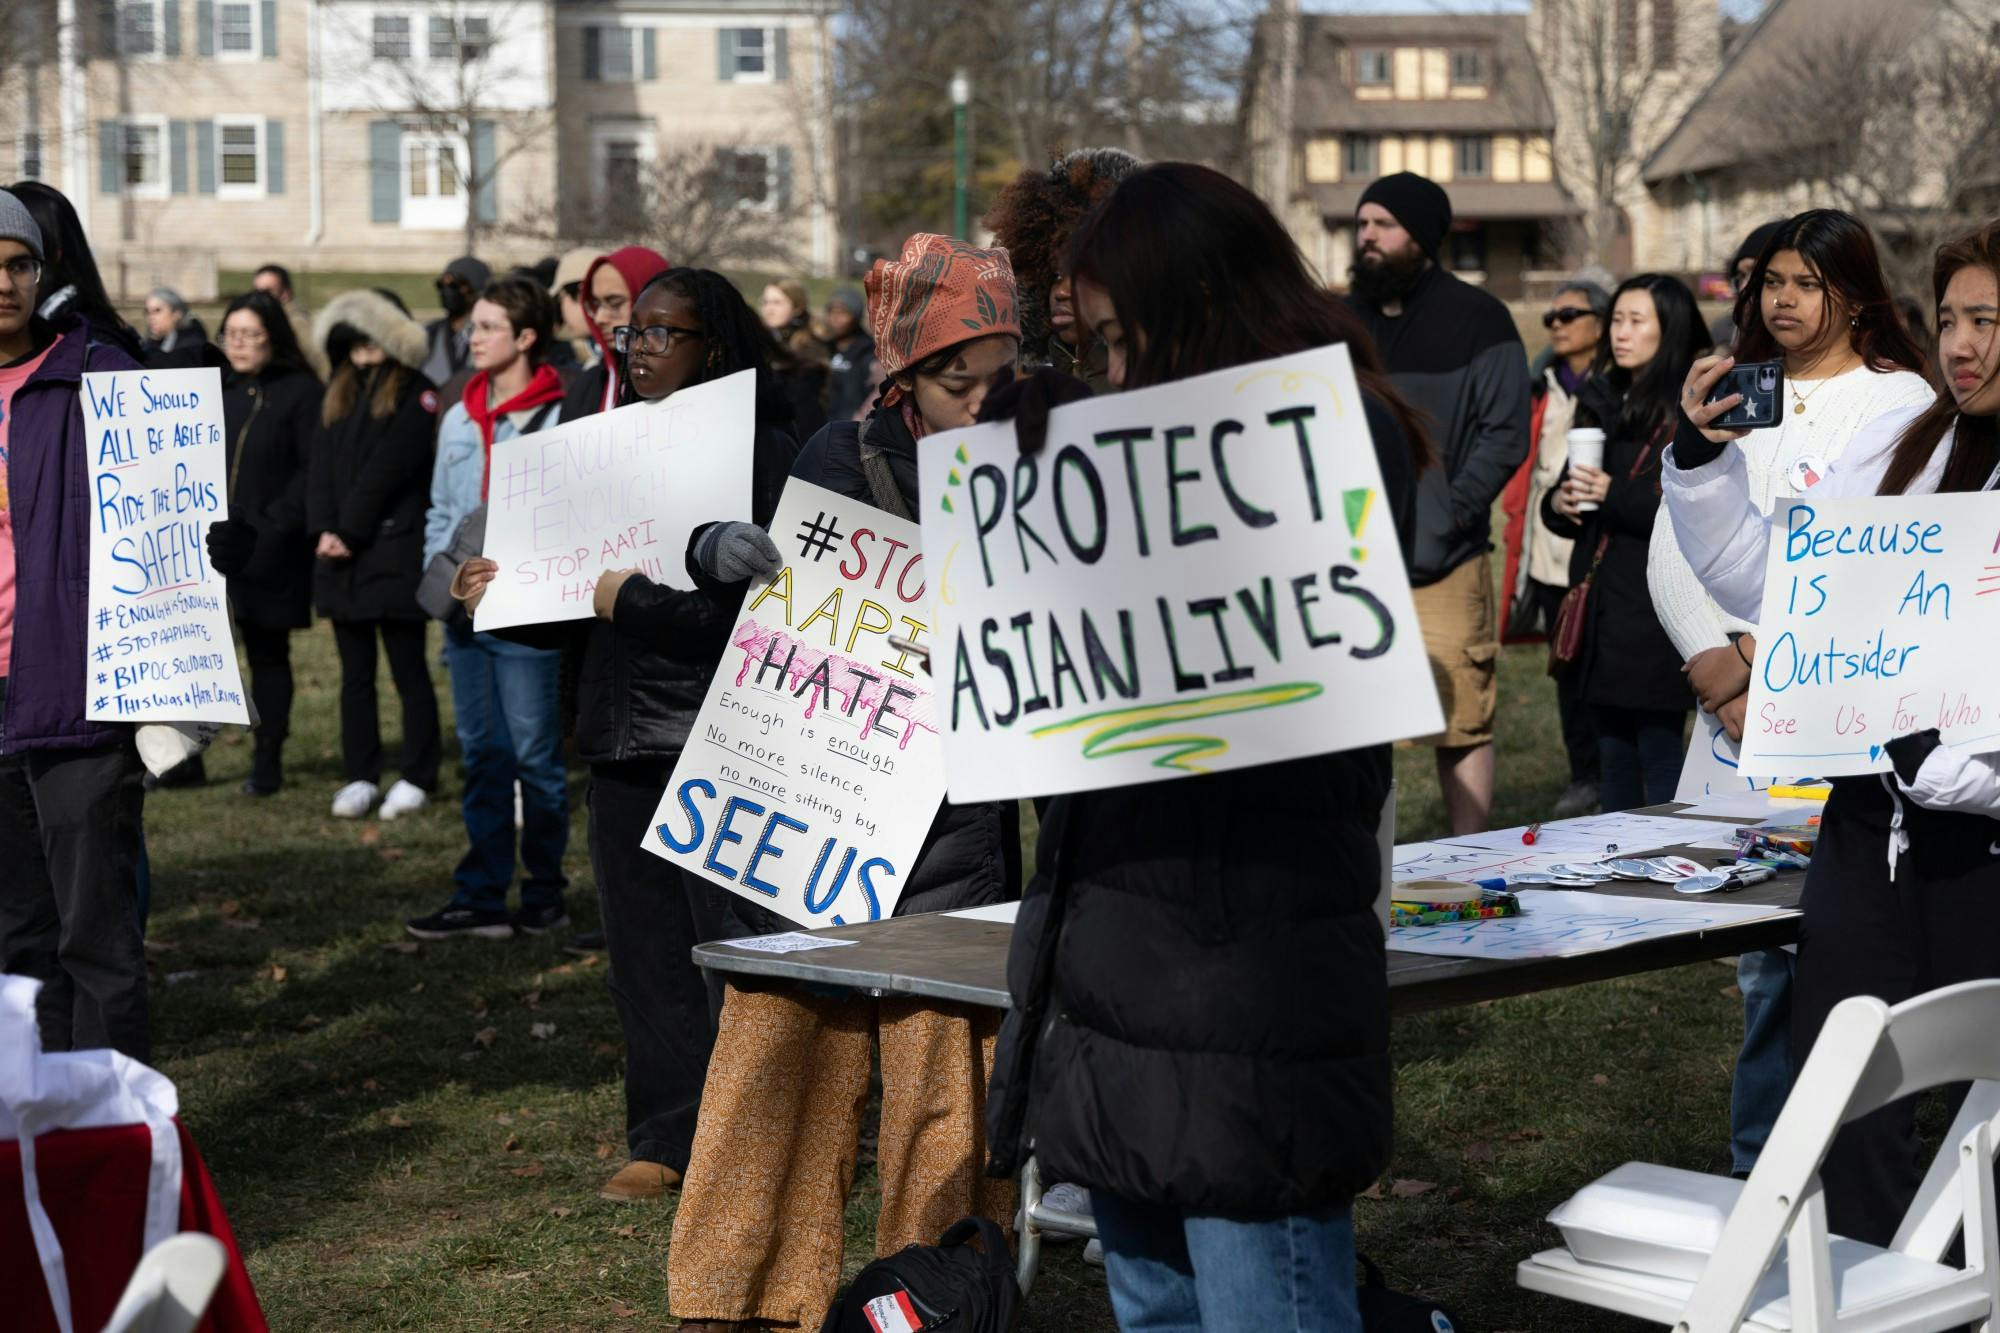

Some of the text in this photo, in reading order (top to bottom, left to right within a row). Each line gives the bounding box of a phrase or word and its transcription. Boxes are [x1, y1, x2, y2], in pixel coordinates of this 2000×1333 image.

[86, 375, 199, 420] WE SHOULD
[98, 422, 220, 466] ALL BE ABLE TO
[501, 402, 700, 511] #ENOUGH IS
[96, 462, 218, 534] RIDE THE BUS
[533, 466, 667, 553] ENOUGH
[968, 405, 1324, 588] PROTECT
[1786, 504, 1944, 562] Because
[516, 518, 658, 586] STOP AAPI
[796, 511, 926, 603] #STO
[748, 566, 928, 679] AAPI
[1898, 569, 1950, 620] An
[754, 637, 917, 739] HATE
[951, 565, 1396, 732] ASIAN LIVES
[1764, 628, 1920, 692] Outsider
[719, 691, 895, 772] Enough is enough
[1760, 692, 1982, 736] See Us For Who
[707, 723, 867, 802] No more silence,
[720, 764, 881, 837] no more sitting by.
[656, 778, 896, 927] SEE US
